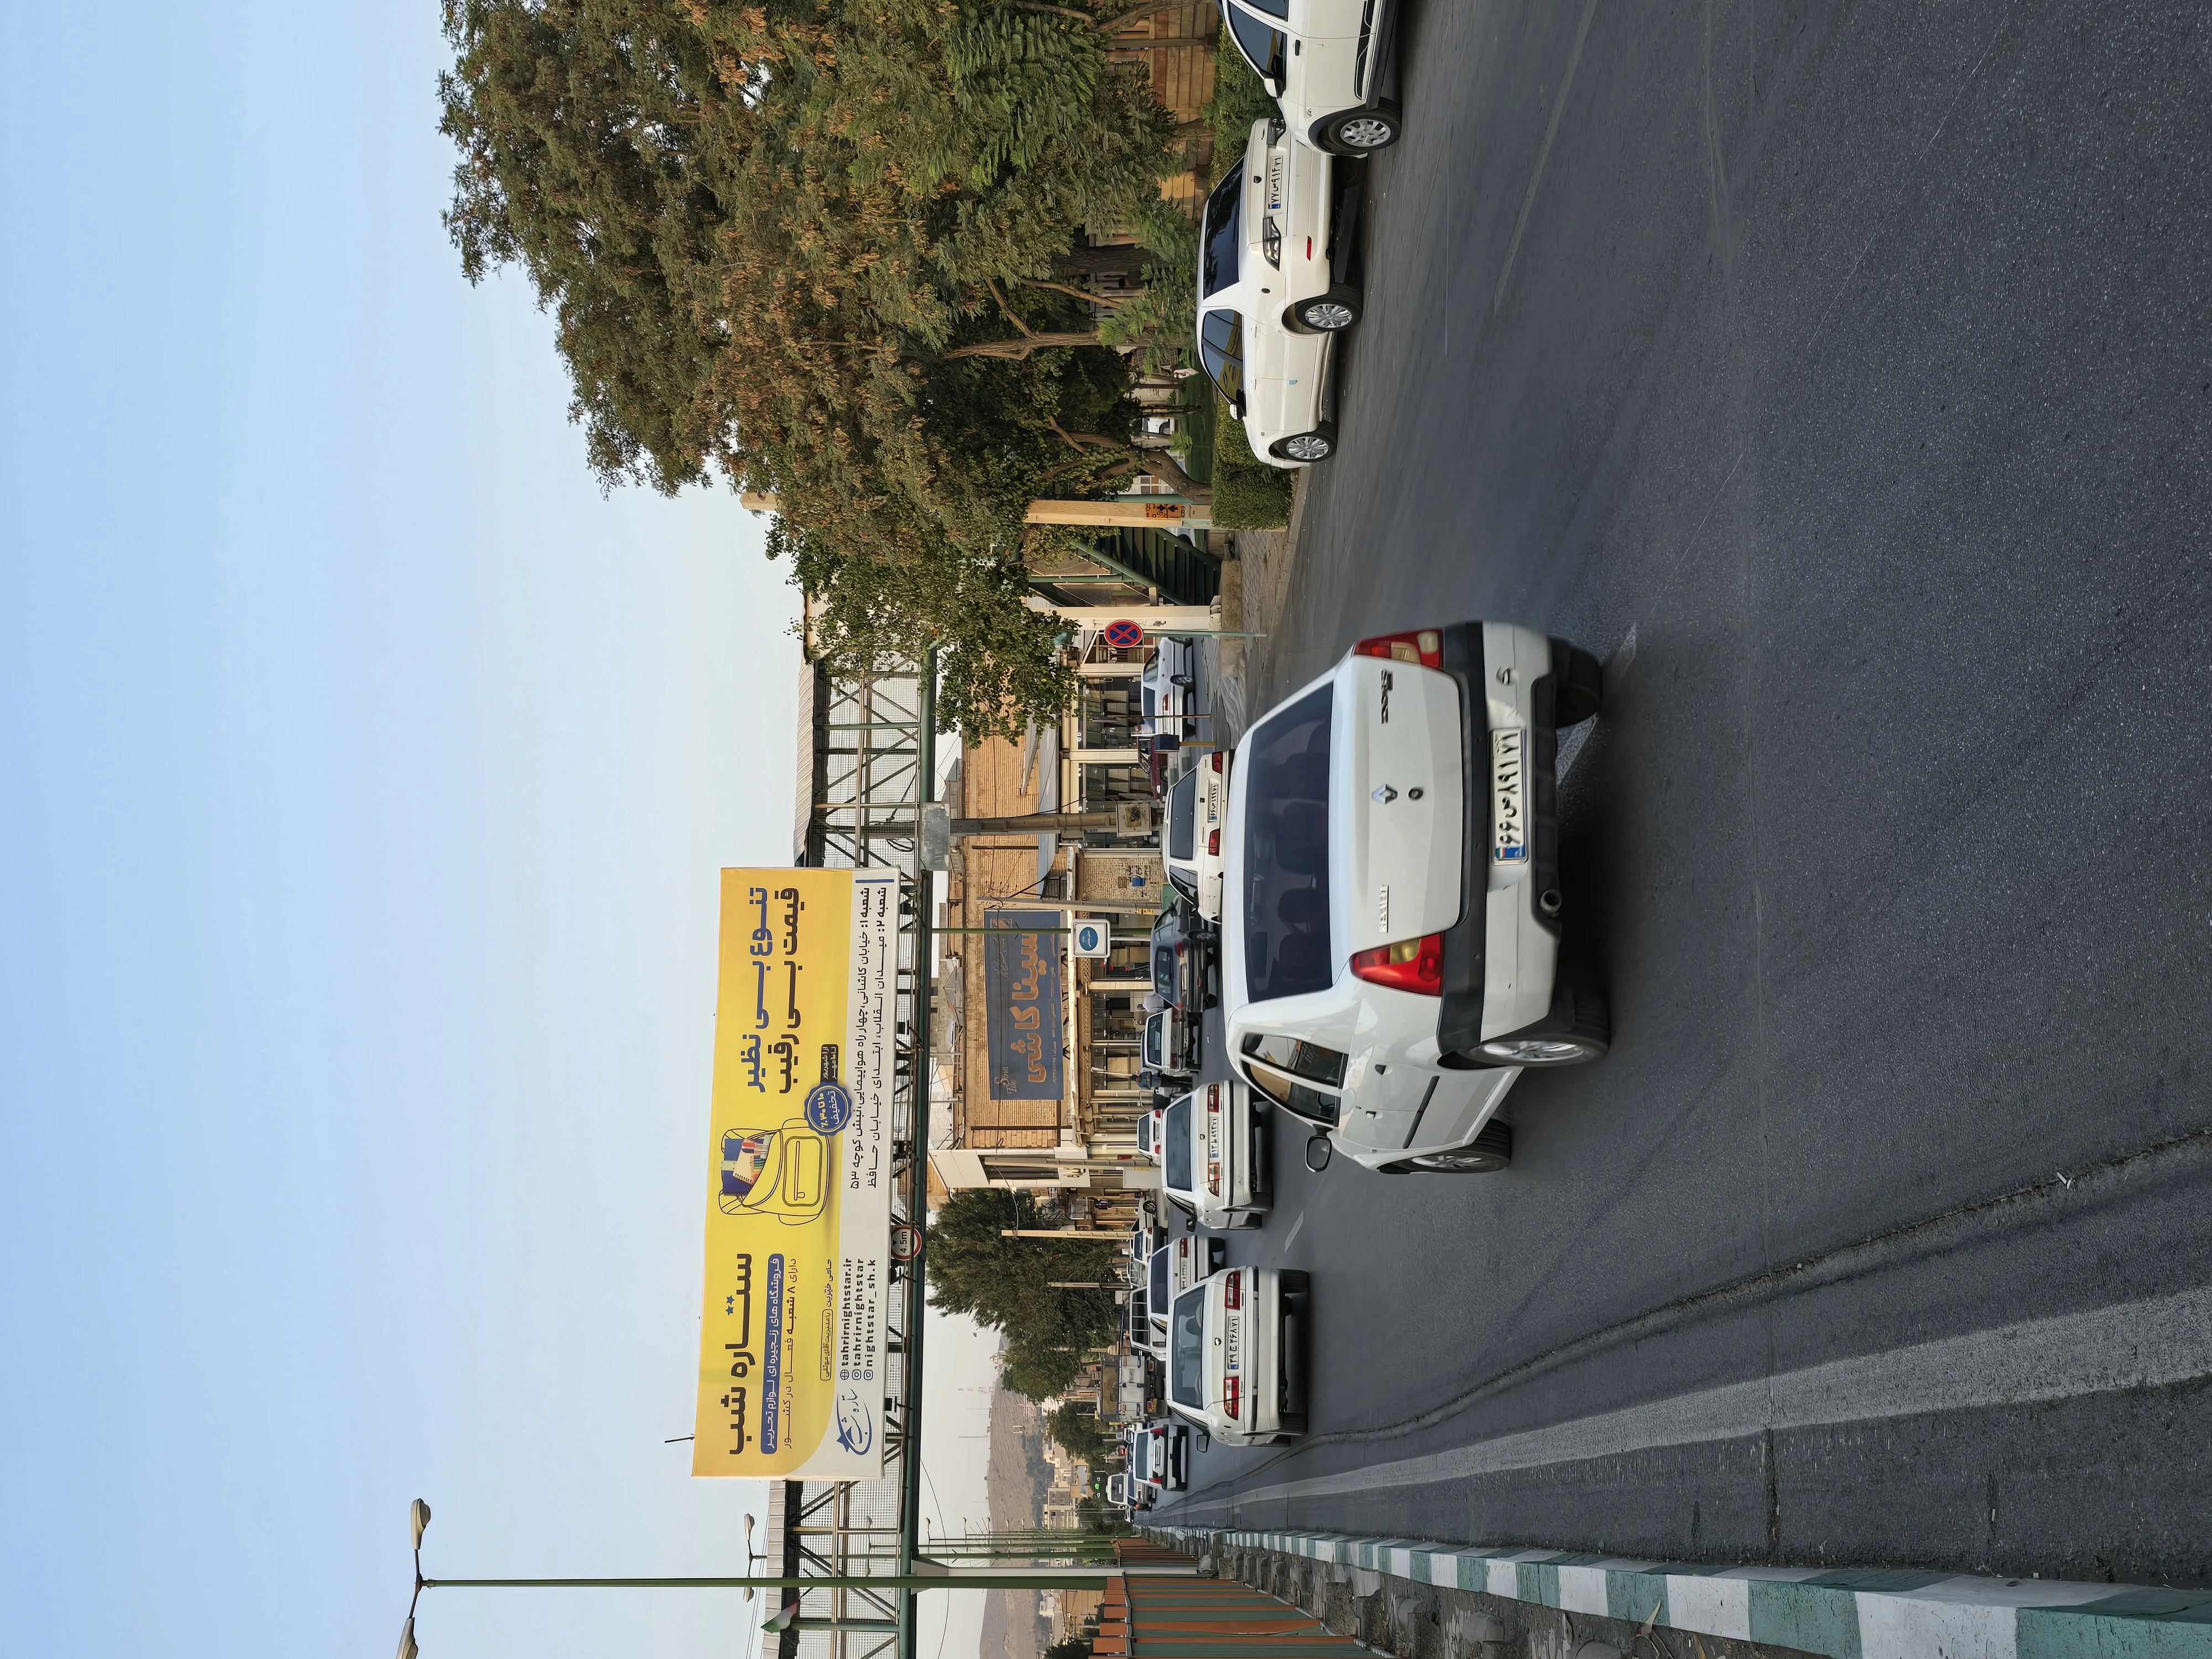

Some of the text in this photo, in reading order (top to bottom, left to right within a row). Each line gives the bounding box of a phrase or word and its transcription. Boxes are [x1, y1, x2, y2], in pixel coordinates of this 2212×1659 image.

[859, 887, 872, 917] شعبه
[877, 887, 888, 917] شعبه
[858, 931, 870, 964] خیابان
[874, 936, 887, 989] میدان
[740, 887, 773, 1093] تنوع بی نظیر
[768, 888, 805, 1094] قیمت بی رقیب
[1010, 933, 1047, 1083] سینا کاشی
[872, 1042, 883, 1088] ابتدای
[994, 1067, 1009, 1087] Sina
[827, 1091, 840, 1125] تخفیف
[870, 1093, 881, 1140] خیابان
[852, 1139, 864, 1168] کوچه
[866, 1144, 878, 1188] حافظ
[850, 1171, 859, 1189] ۵۳
[789, 1259, 798, 1283] دارای
[825, 1259, 833, 1281] حامی
[786, 1297, 797, 1334] شعبه
[841, 1258, 852, 1366] tahrirnightstar.ir
[853, 1259, 864, 1366] tahrirnightstar
[865, 1259, 877, 1367] nightstar_sh.k
[721, 1254, 755, 1455] ستاره شب
[765, 1258, 781, 1449] فروشگاه های زنجیره ای لوازم تحریر
[784, 1338, 794, 1383] فعال
[785, 1386, 794, 1397] در
[782, 1400, 792, 1449] کشور
[841, 1415, 868, 1444] شب
